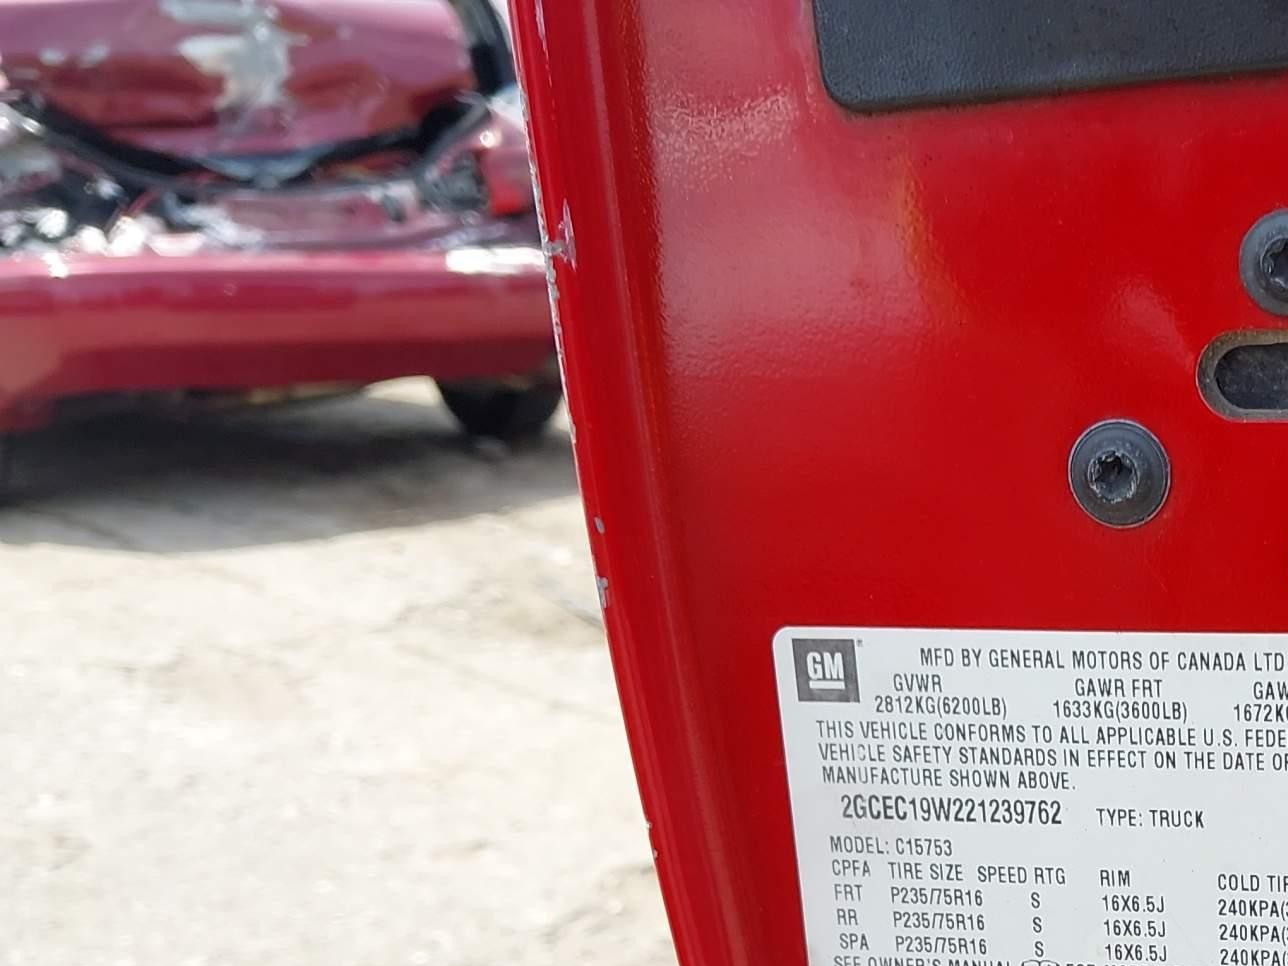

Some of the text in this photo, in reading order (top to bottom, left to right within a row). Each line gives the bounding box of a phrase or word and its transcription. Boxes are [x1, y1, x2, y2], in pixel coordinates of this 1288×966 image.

[806, 651, 845, 681] GM
[920, 647, 954, 667] MFD
[962, 648, 981, 667] BY
[988, 649, 1065, 669] GENERAL
[1072, 650, 1142, 670] MOTORS
[1149, 651, 1170, 671] OF
[1177, 652, 1246, 672] CANADA
[893, 673, 943, 692] GVWR
[1075, 678, 1163, 698] GAWR FRT
[875, 695, 1008, 720] 2812KG(6200LB)
[1053, 701, 1188, 725] 1633KG(3600LB)
[816, 720, 855, 739] THIS
[859, 721, 927, 741] VEHICLE
[934, 723, 1026, 743] CONFORMS
[1032, 725, 1053, 744] TO
[1059, 726, 1088, 745] ALL
[1096, 727, 1197, 746] APPLICABLE
[1203, 729, 1238, 747] U.S.
[817, 743, 885, 763] VEHICLE
[892, 744, 952, 765] SAFETY
[958, 747, 1057, 767] STANDARDS
[1064, 749, 1080, 767] IN
[1088, 750, 1147, 769] EFFECT
[1154, 751, 1176, 770] ON
[1184, 752, 1216, 770] THE
[1223, 752, 1265, 771] DATE
[822, 766, 1077, 790] MANUFACTURE SHOWN ABOVE.
[841, 794, 1062, 825] 2GCEC19W221239762
[1096, 807, 1205, 829] TYPE: TRUCK
[830, 835, 953, 856] MODEL: C15753
[832, 859, 871, 877] CPFA
[888, 861, 964, 881] TIRE SIZE
[977, 865, 1066, 885] SPEED RTG
[1100, 869, 1131, 888] RIM
[1217, 873, 1260, 892] COLD
[834, 884, 863, 901] FRT
[890, 886, 983, 907] P235/75R16
[1031, 891, 1041, 909] S
[1101, 894, 1165, 913] 16X6.5J
[836, 908, 858, 925] RR
[893, 911, 985, 931] P235/75R16
[1032, 916, 1042, 933] S
[1103, 919, 1166, 938] 16X6.5J
[839, 933, 869, 951] SPA
[895, 935, 987, 955] P235/75R16
[1034, 941, 1044, 957] S
[1104, 944, 1167, 962] 16X6.5J
